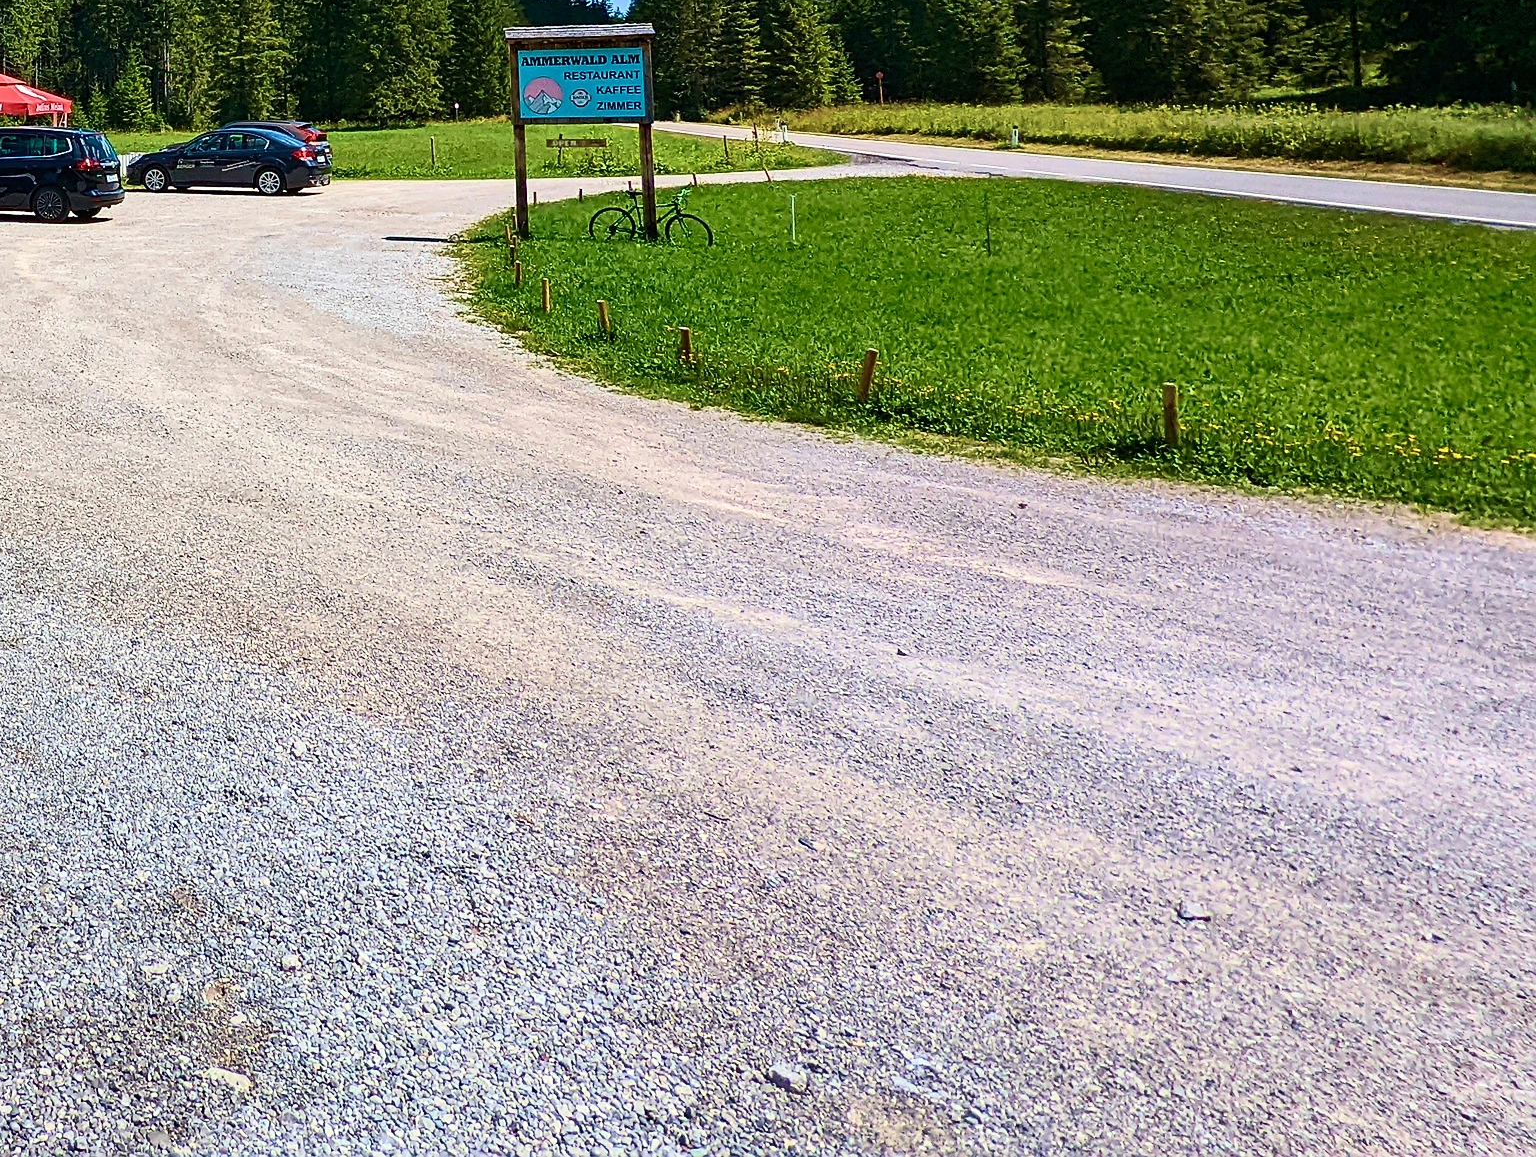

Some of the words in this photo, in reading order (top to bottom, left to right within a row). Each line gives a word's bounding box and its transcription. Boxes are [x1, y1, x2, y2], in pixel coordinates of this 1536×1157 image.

[521, 55, 607, 66] AMMERWALD
[611, 54, 640, 64] ALM
[564, 70, 640, 80] RESTAURANT
[596, 86, 641, 95] KAFFEE
[597, 101, 642, 111] ZIMMER
